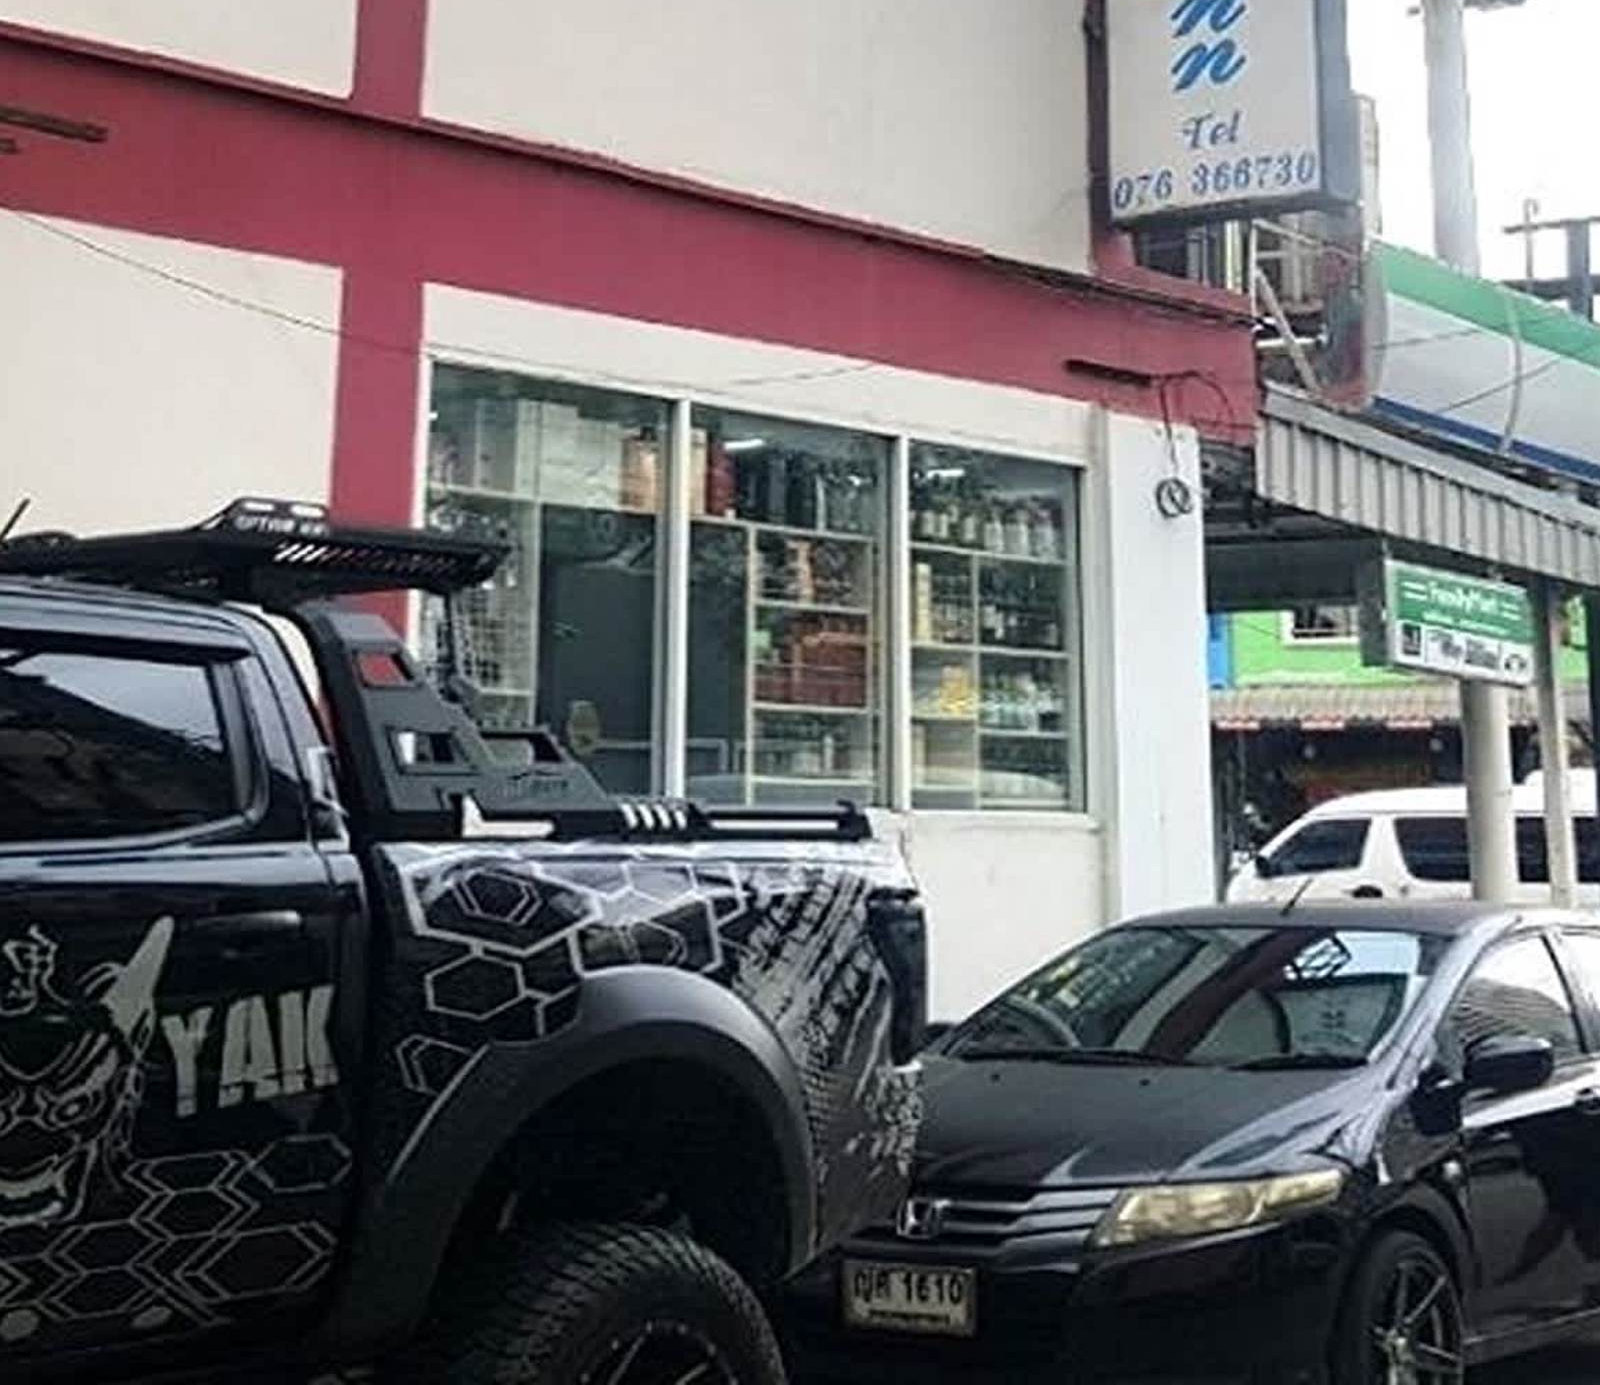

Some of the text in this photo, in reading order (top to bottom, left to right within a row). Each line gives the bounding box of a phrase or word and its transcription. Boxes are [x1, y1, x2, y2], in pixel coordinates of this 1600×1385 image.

[1182, 111, 1241, 149] Tel
[1114, 152, 1316, 210] 076 366730
[160, 985, 339, 1117] YAK
[904, 1271, 962, 1305] 1610
